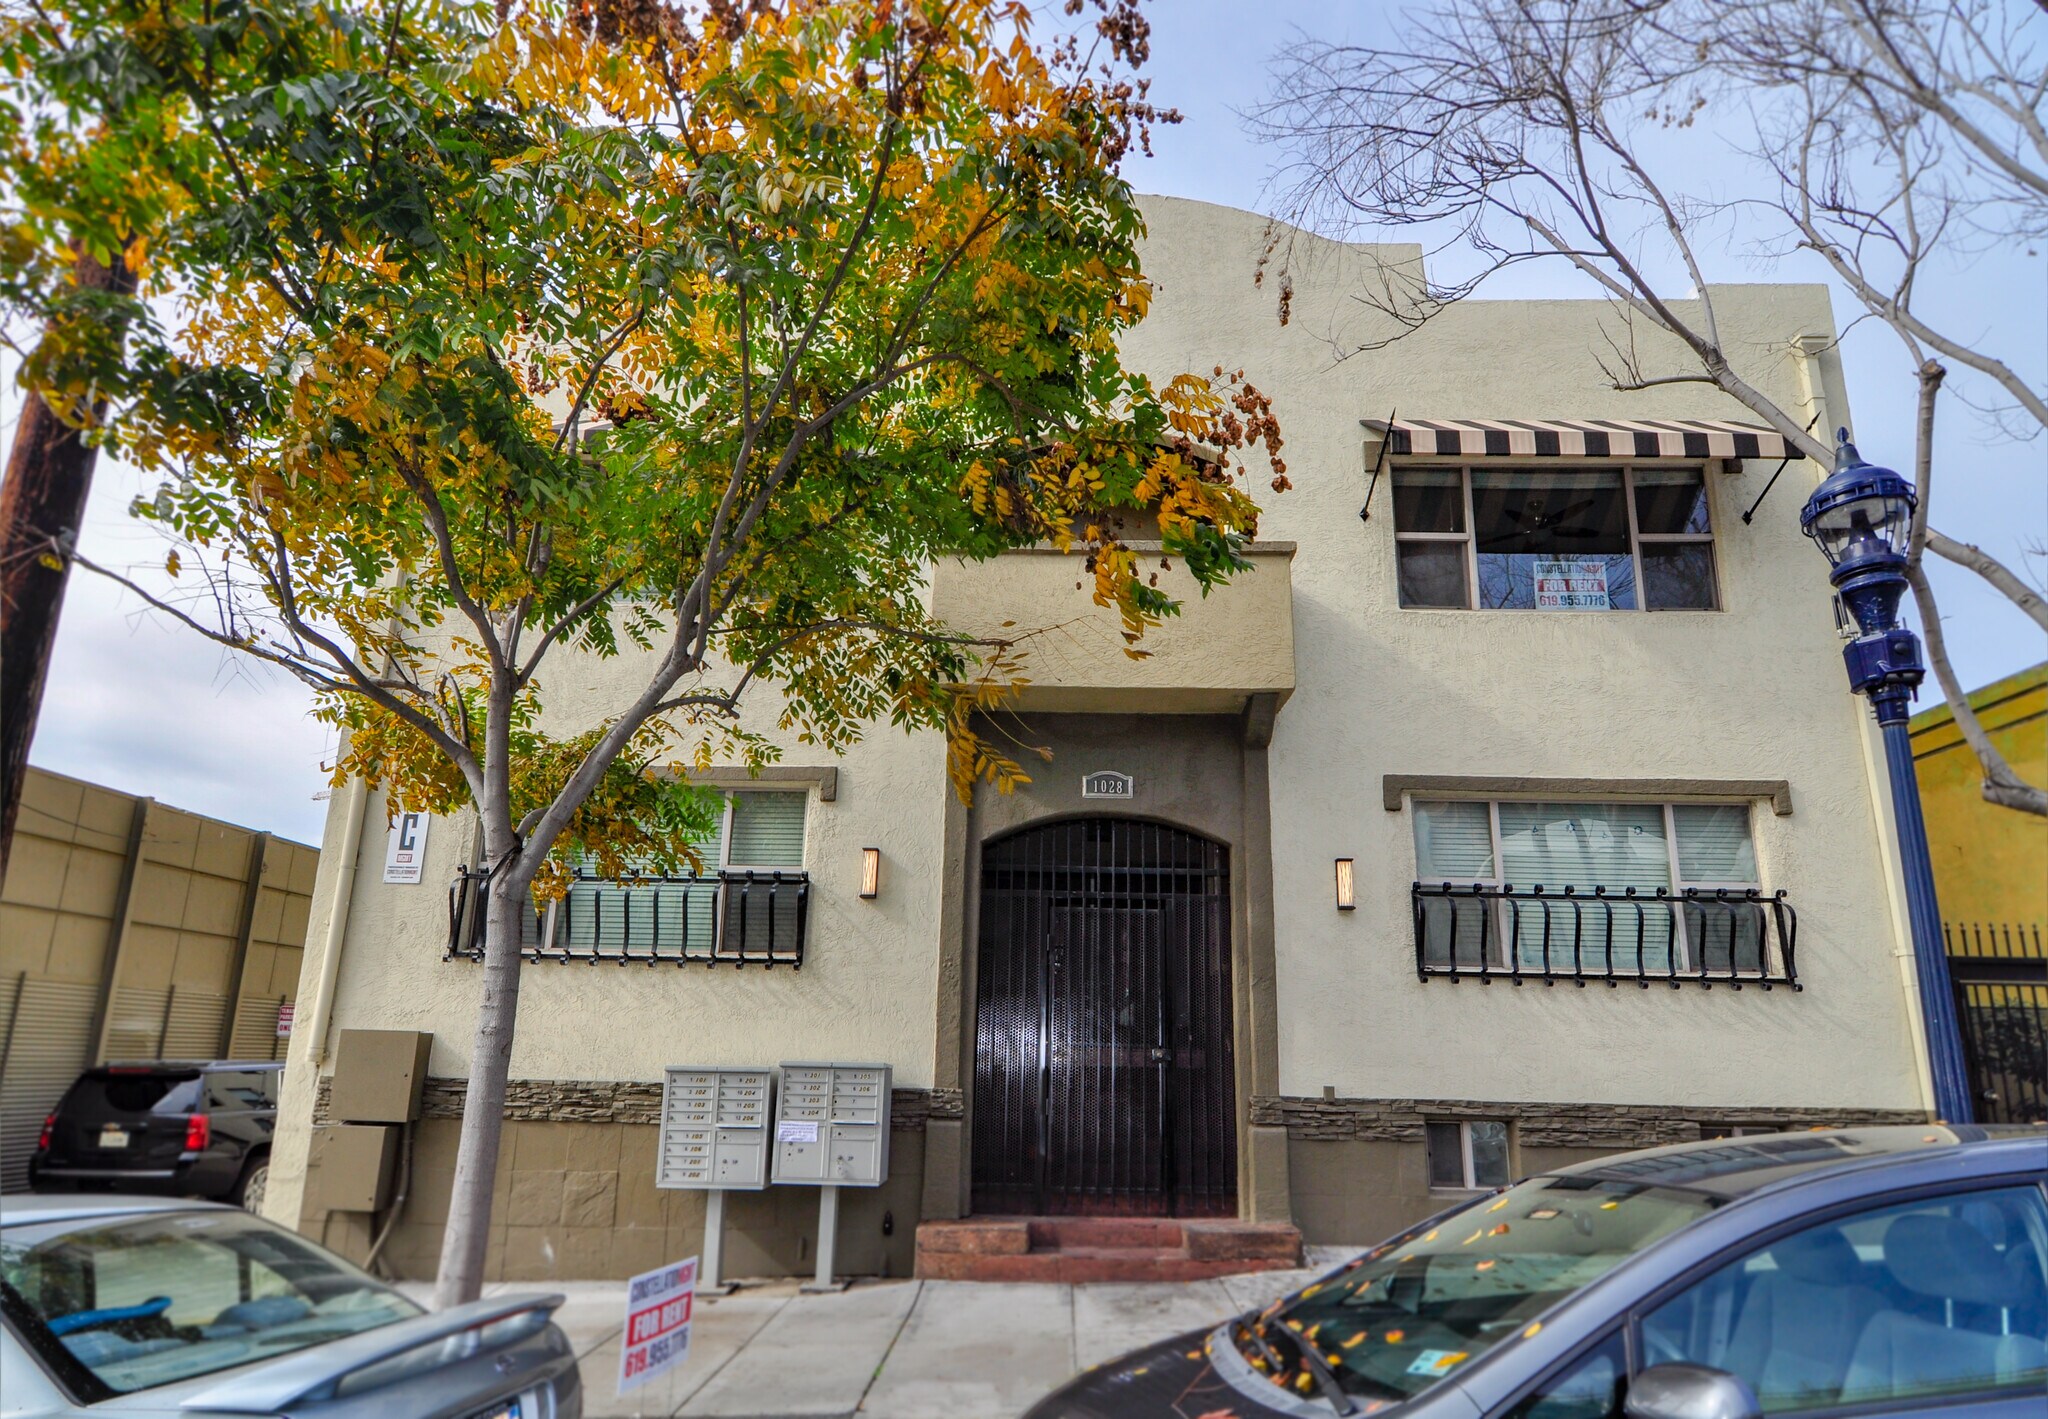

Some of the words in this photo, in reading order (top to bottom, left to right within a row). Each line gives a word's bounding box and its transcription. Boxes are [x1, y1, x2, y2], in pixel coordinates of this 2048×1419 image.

[1543, 579, 1566, 591] FOR
[1569, 579, 1599, 591] RENT
[1539, 594, 1606, 606] 619.955.7776
[1093, 780, 1123, 794] 1028
[399, 814, 419, 851] C
[632, 1309, 661, 1343] FOR
[661, 1296, 688, 1329] RENT
